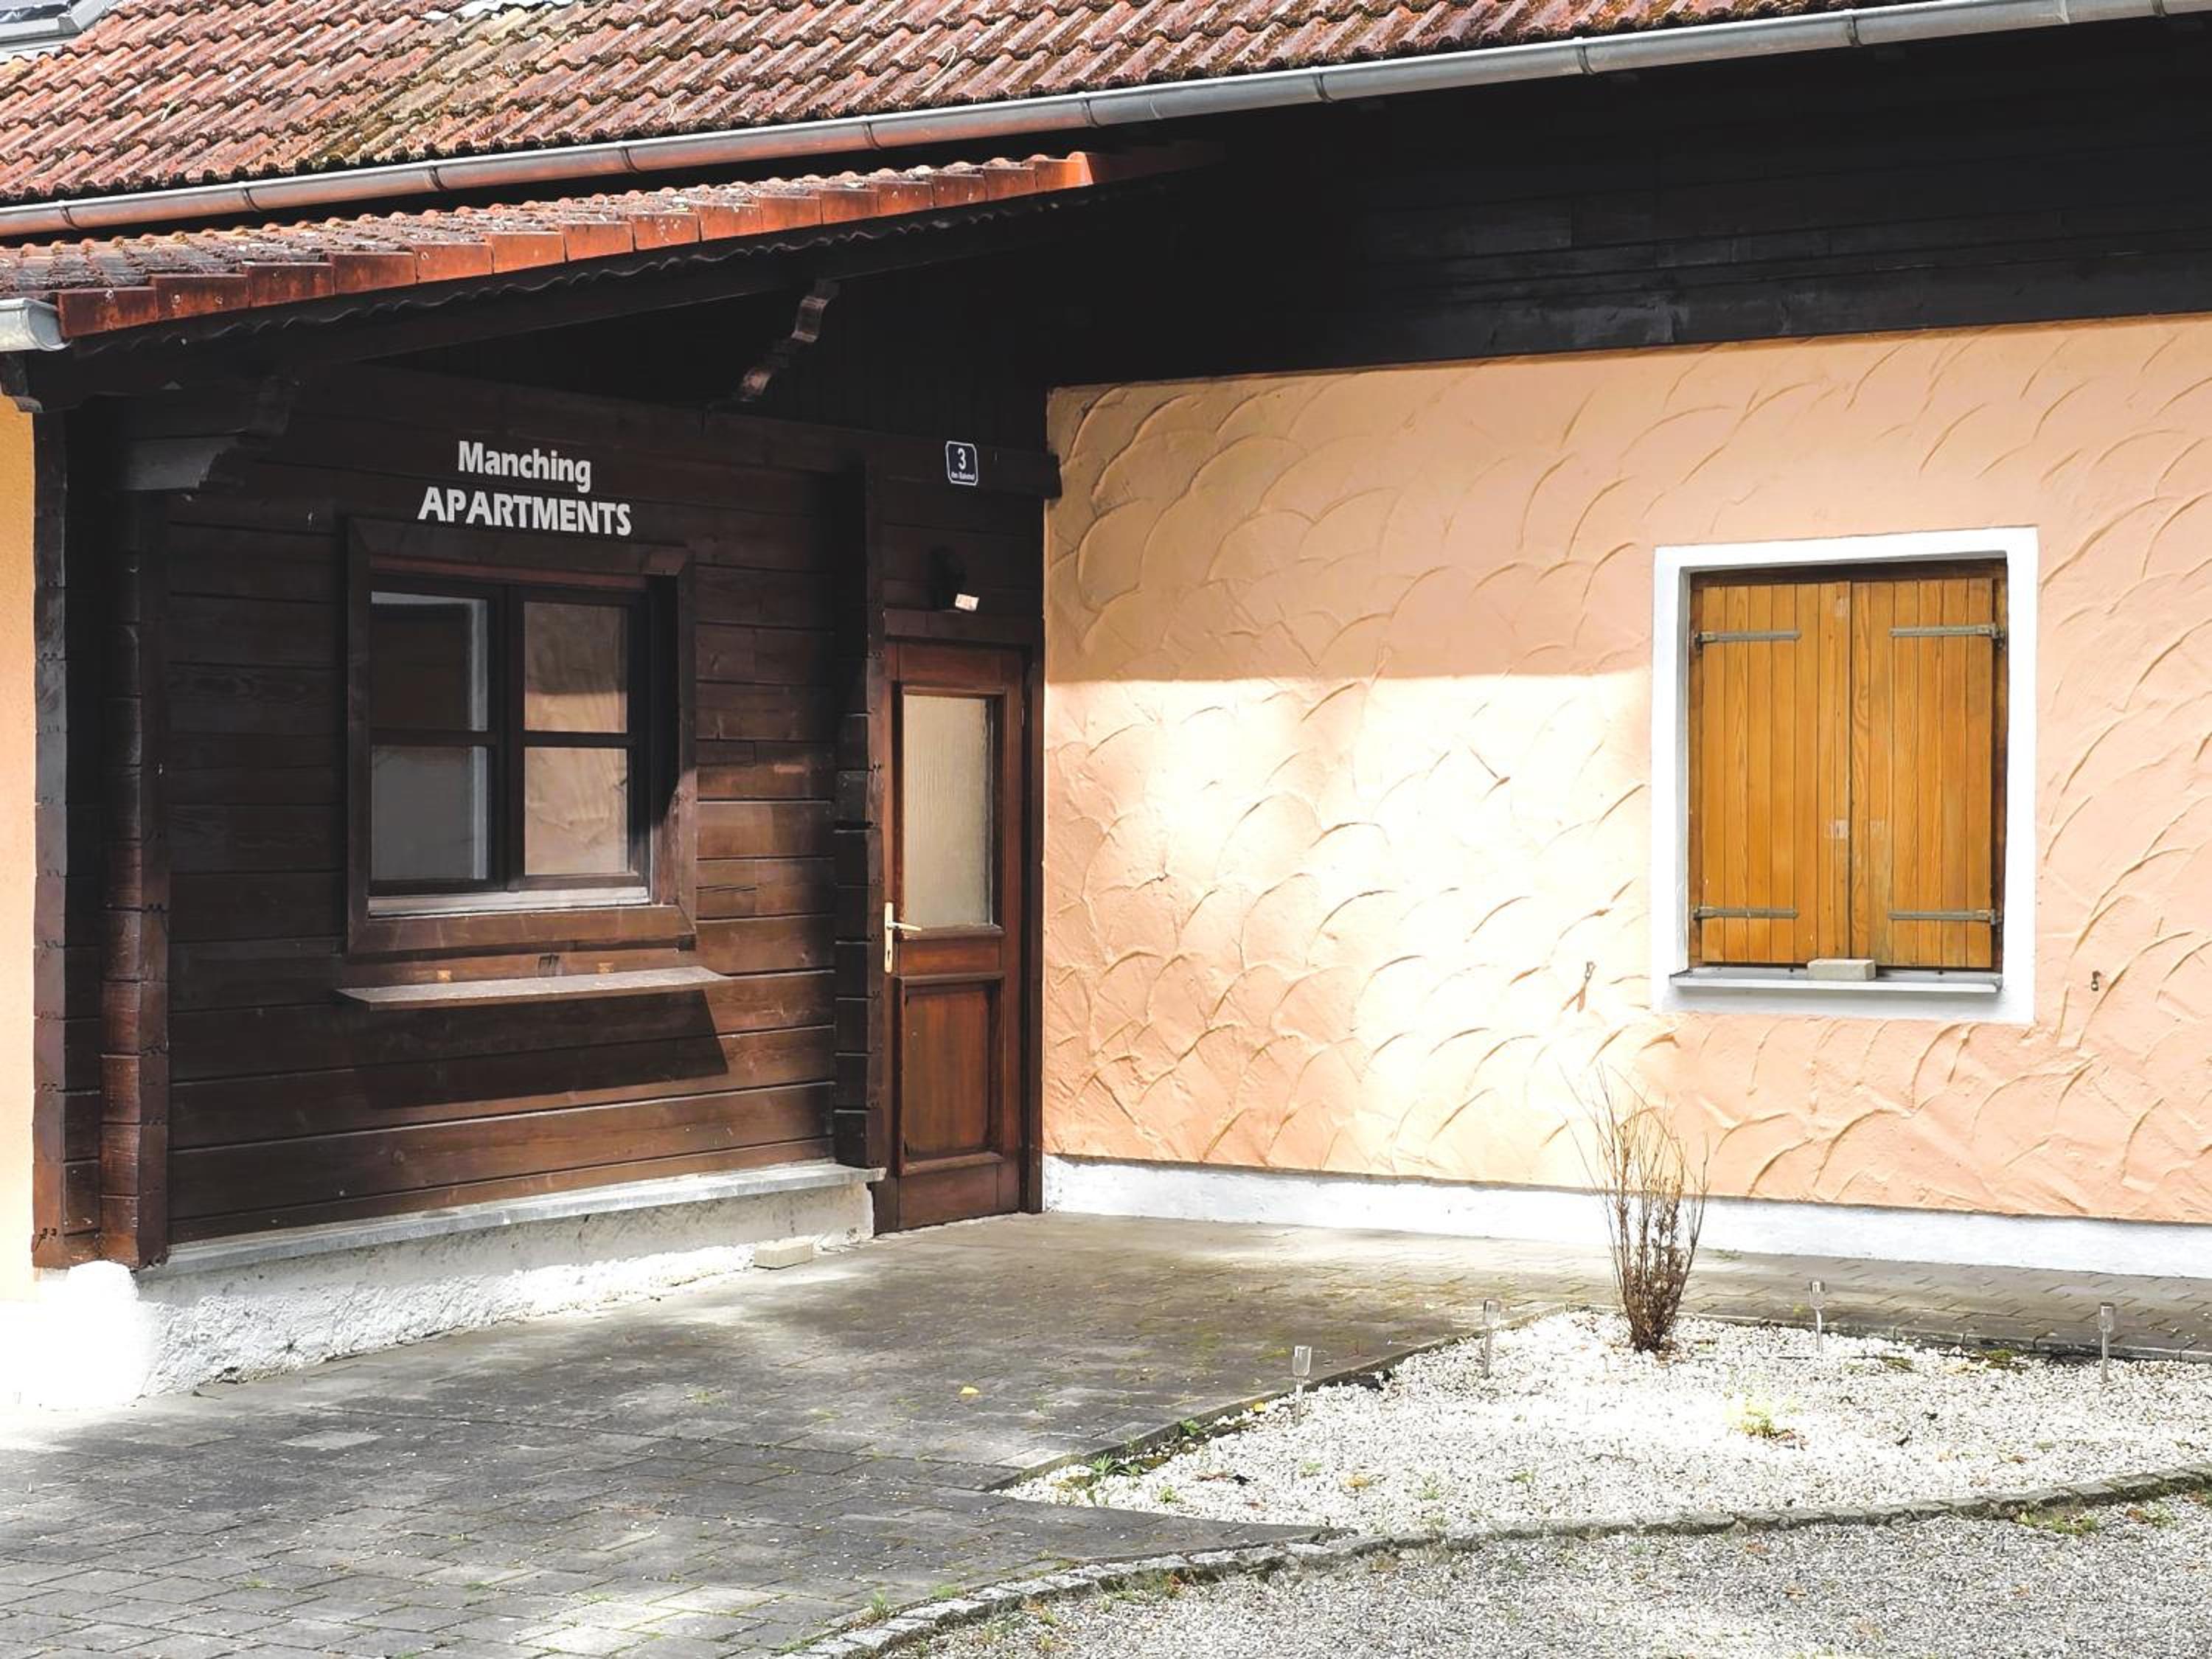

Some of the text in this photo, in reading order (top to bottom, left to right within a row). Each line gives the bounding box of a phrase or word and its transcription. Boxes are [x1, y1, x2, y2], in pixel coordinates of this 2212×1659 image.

[458, 440, 591, 493] Manching
[958, 448, 967, 470] 3
[417, 486, 632, 536] APARTMENTS
